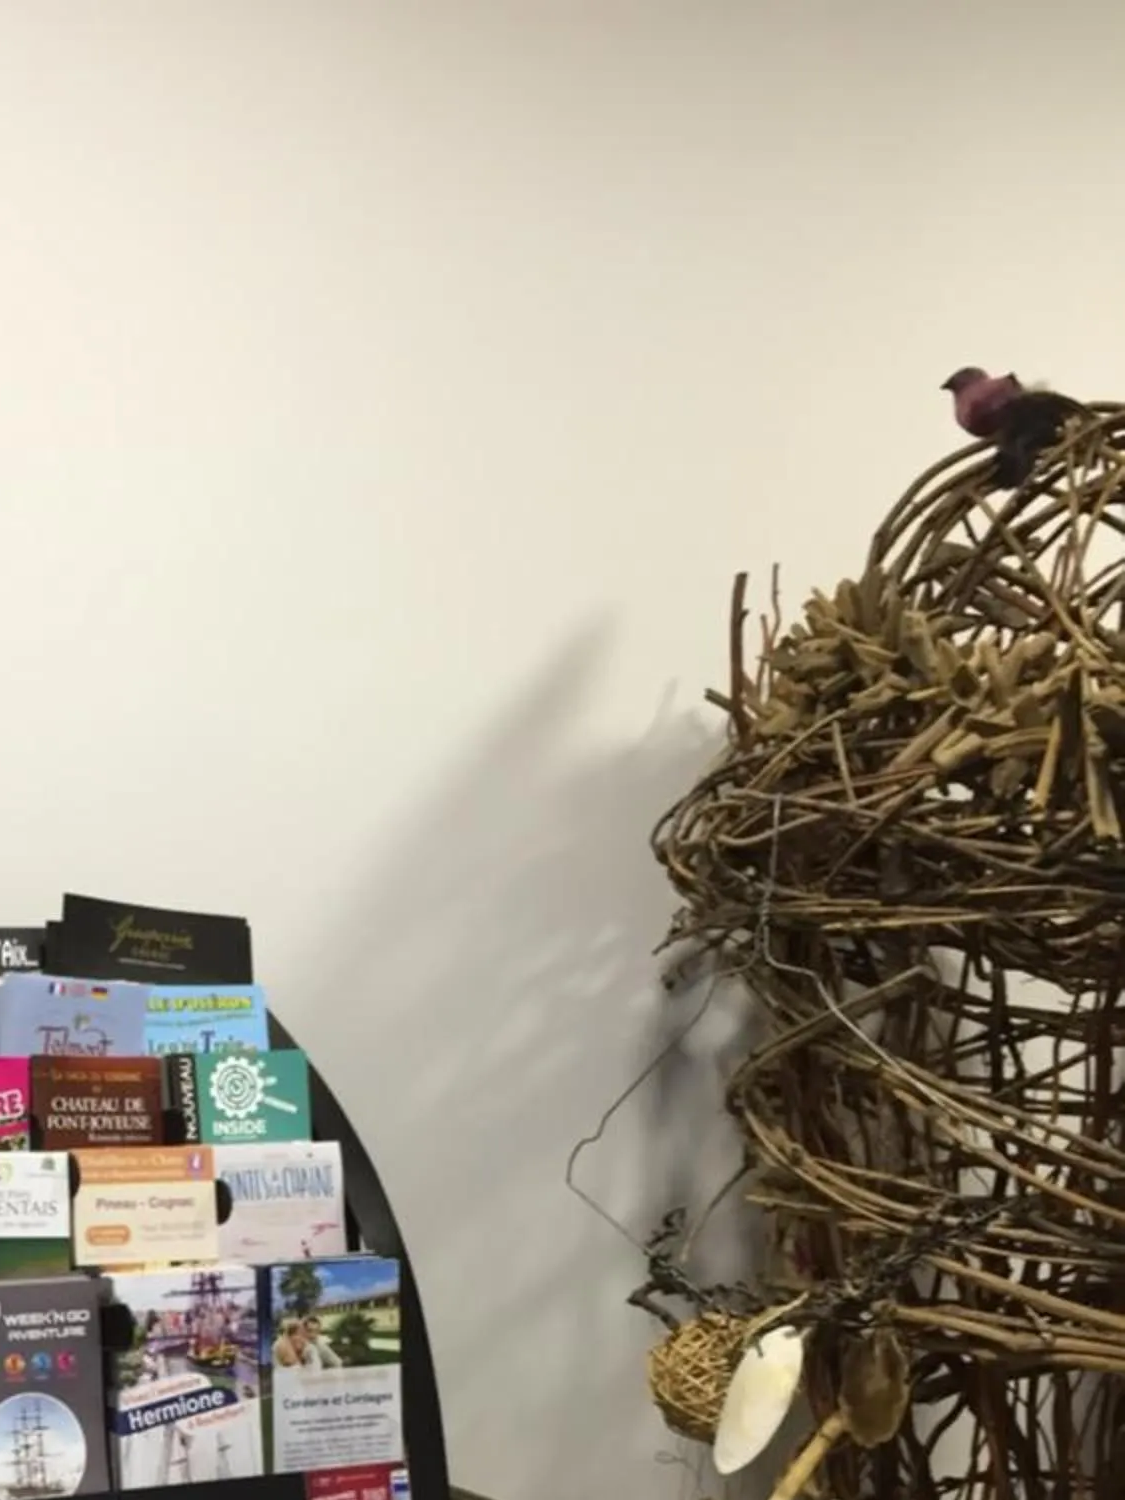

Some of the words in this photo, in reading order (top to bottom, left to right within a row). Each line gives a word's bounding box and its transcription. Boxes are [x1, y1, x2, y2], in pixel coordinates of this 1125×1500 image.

[179, 1056, 198, 1140] NOUVEAU
[212, 1118, 267, 1136] INSIDE
[127, 1389, 225, 1431] Hermione
